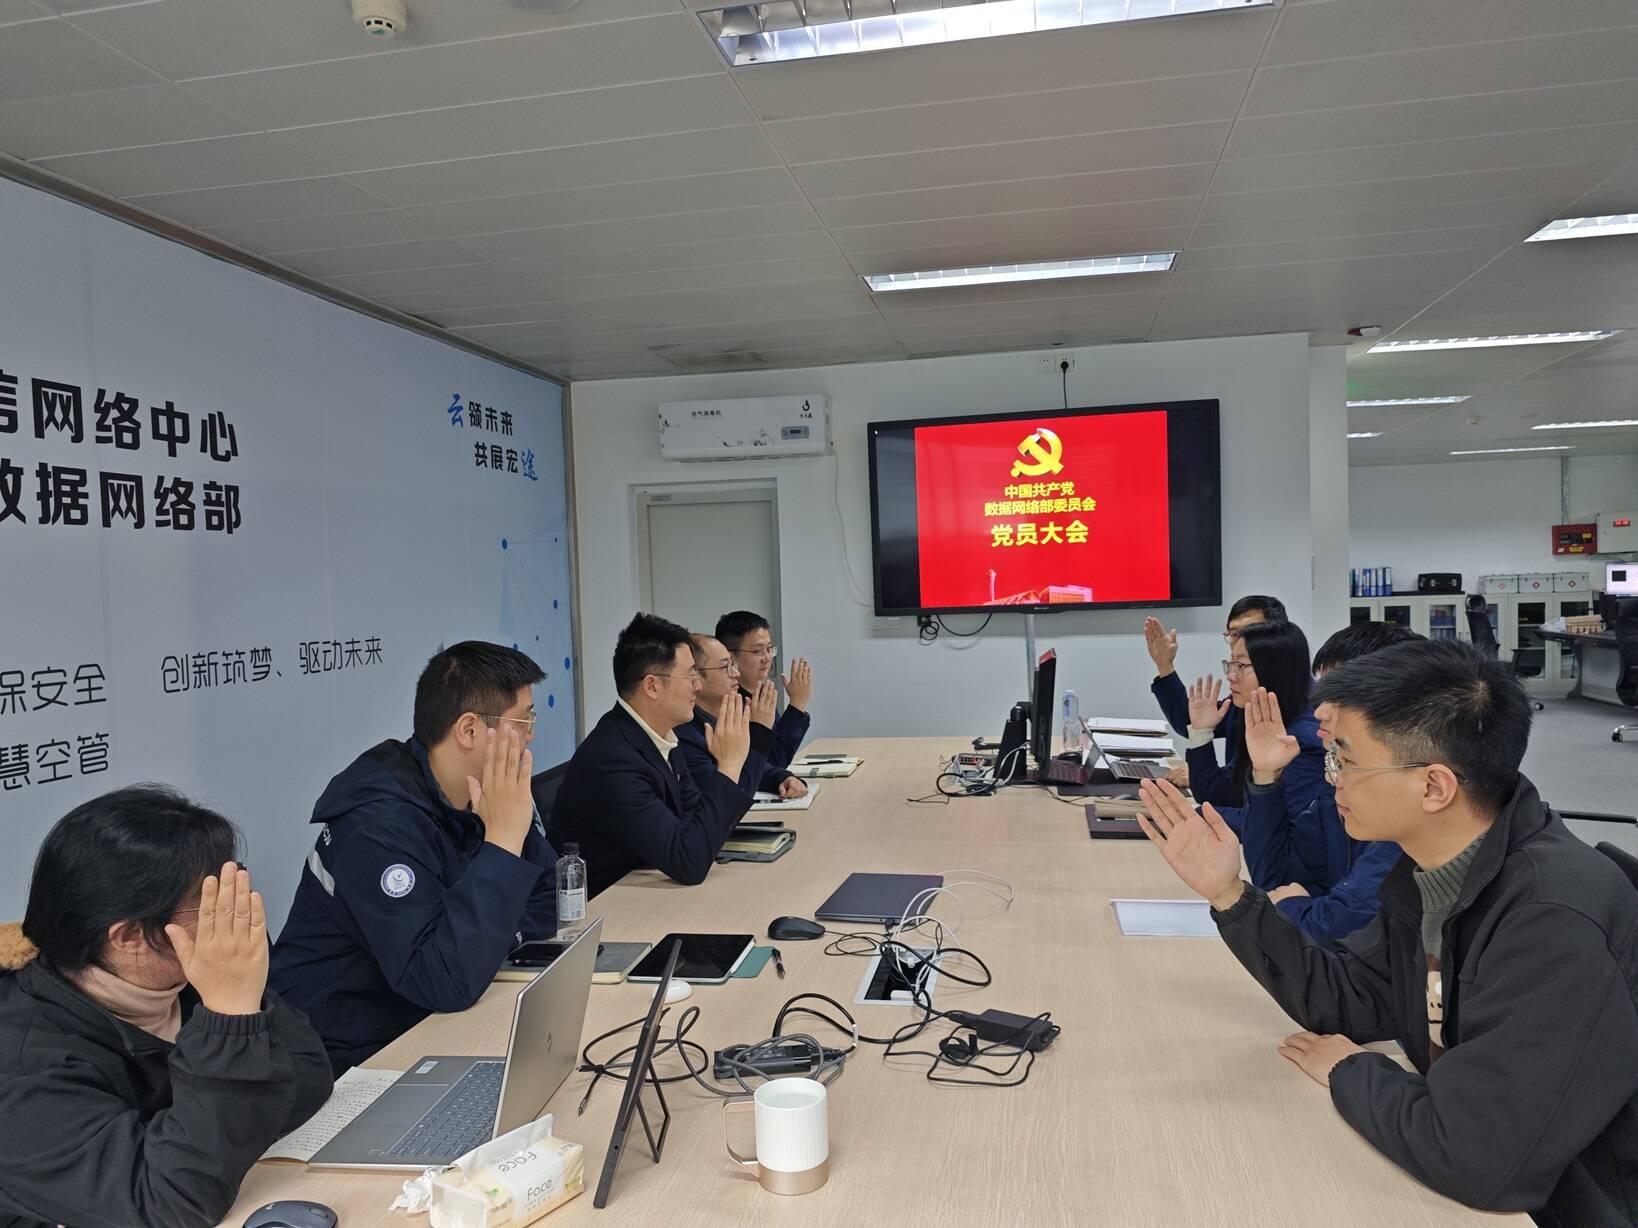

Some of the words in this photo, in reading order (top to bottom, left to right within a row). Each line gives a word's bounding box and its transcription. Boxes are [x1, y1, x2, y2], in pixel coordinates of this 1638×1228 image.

[474, 441, 539, 481] 共展宏途
[1004, 481, 1075, 499] 中国共产党
[984, 496, 1096, 517] 数据网络部委员会
[991, 520, 1089, 547] 党员大会
[0, 732, 110, 791] 慧空管
